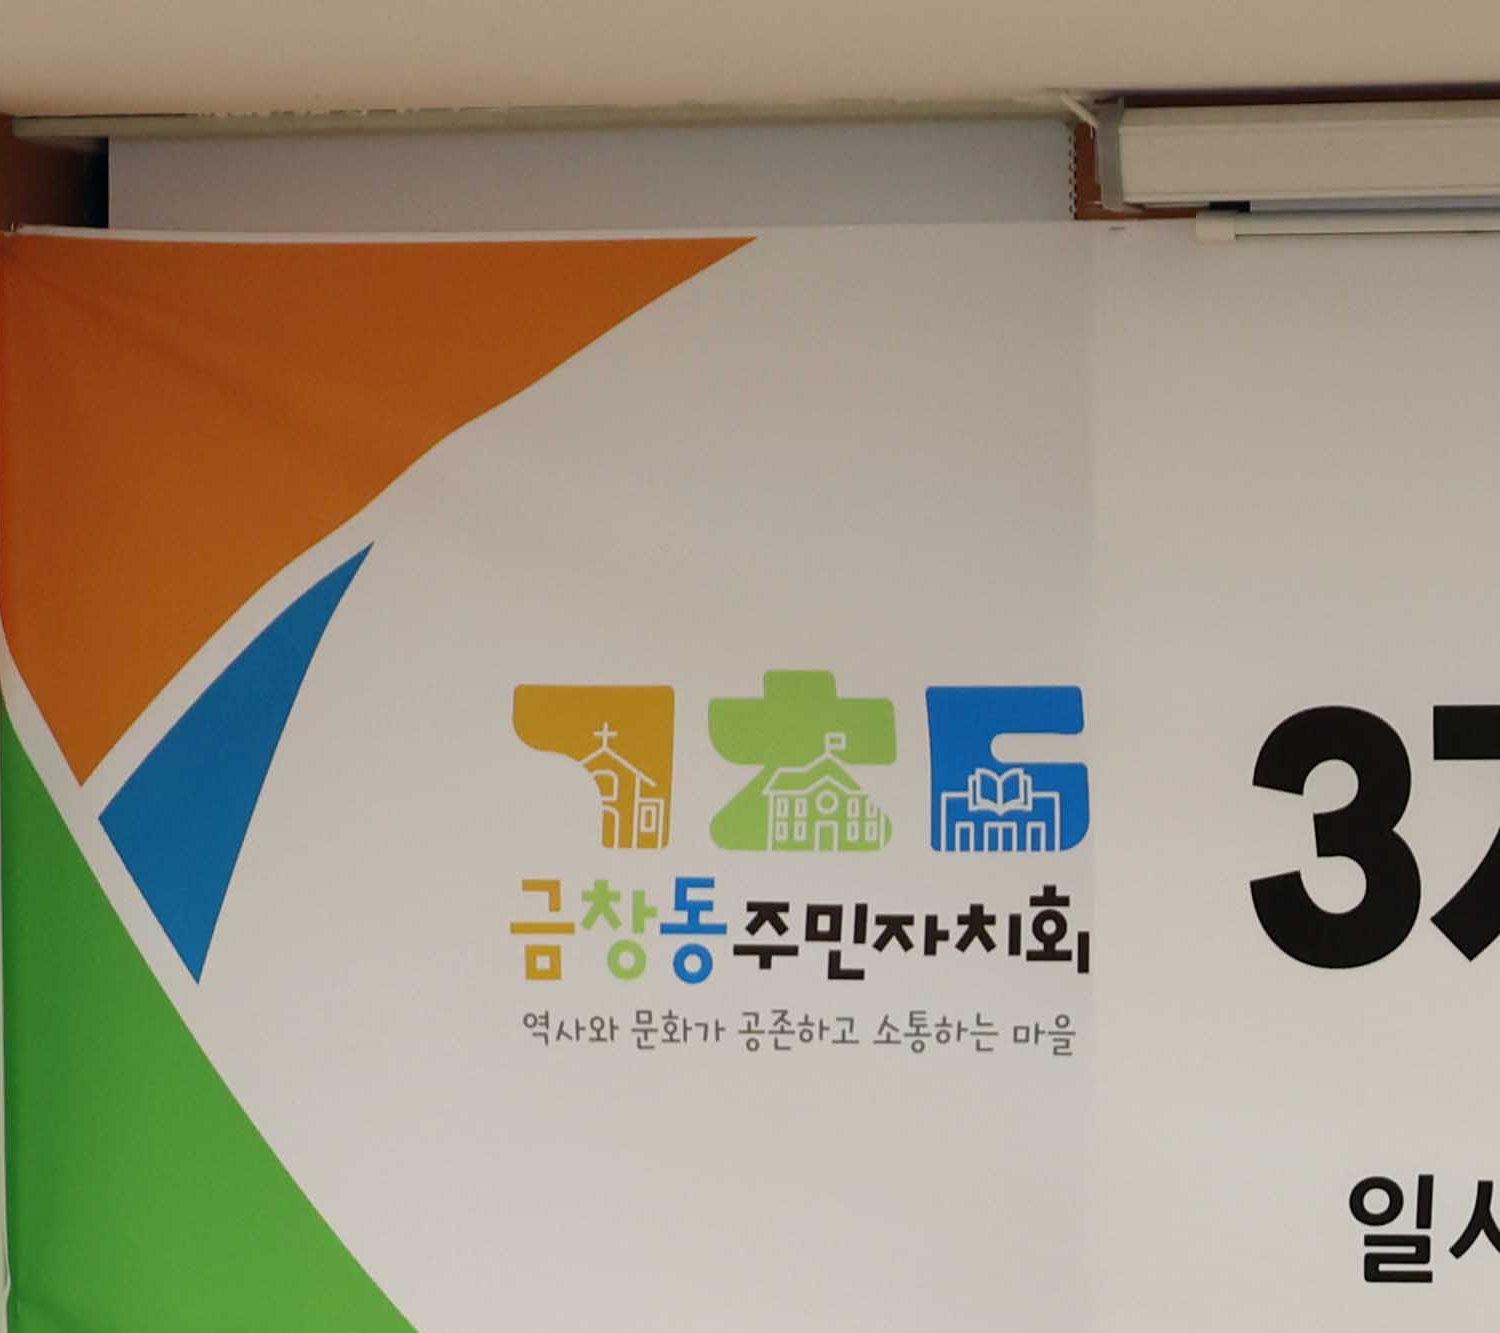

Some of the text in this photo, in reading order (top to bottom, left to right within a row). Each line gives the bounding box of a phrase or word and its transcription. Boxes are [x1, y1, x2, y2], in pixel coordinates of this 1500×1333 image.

[522, 1009, 1076, 1056] 역사와 문화가 공존하고 소통하는 마을
